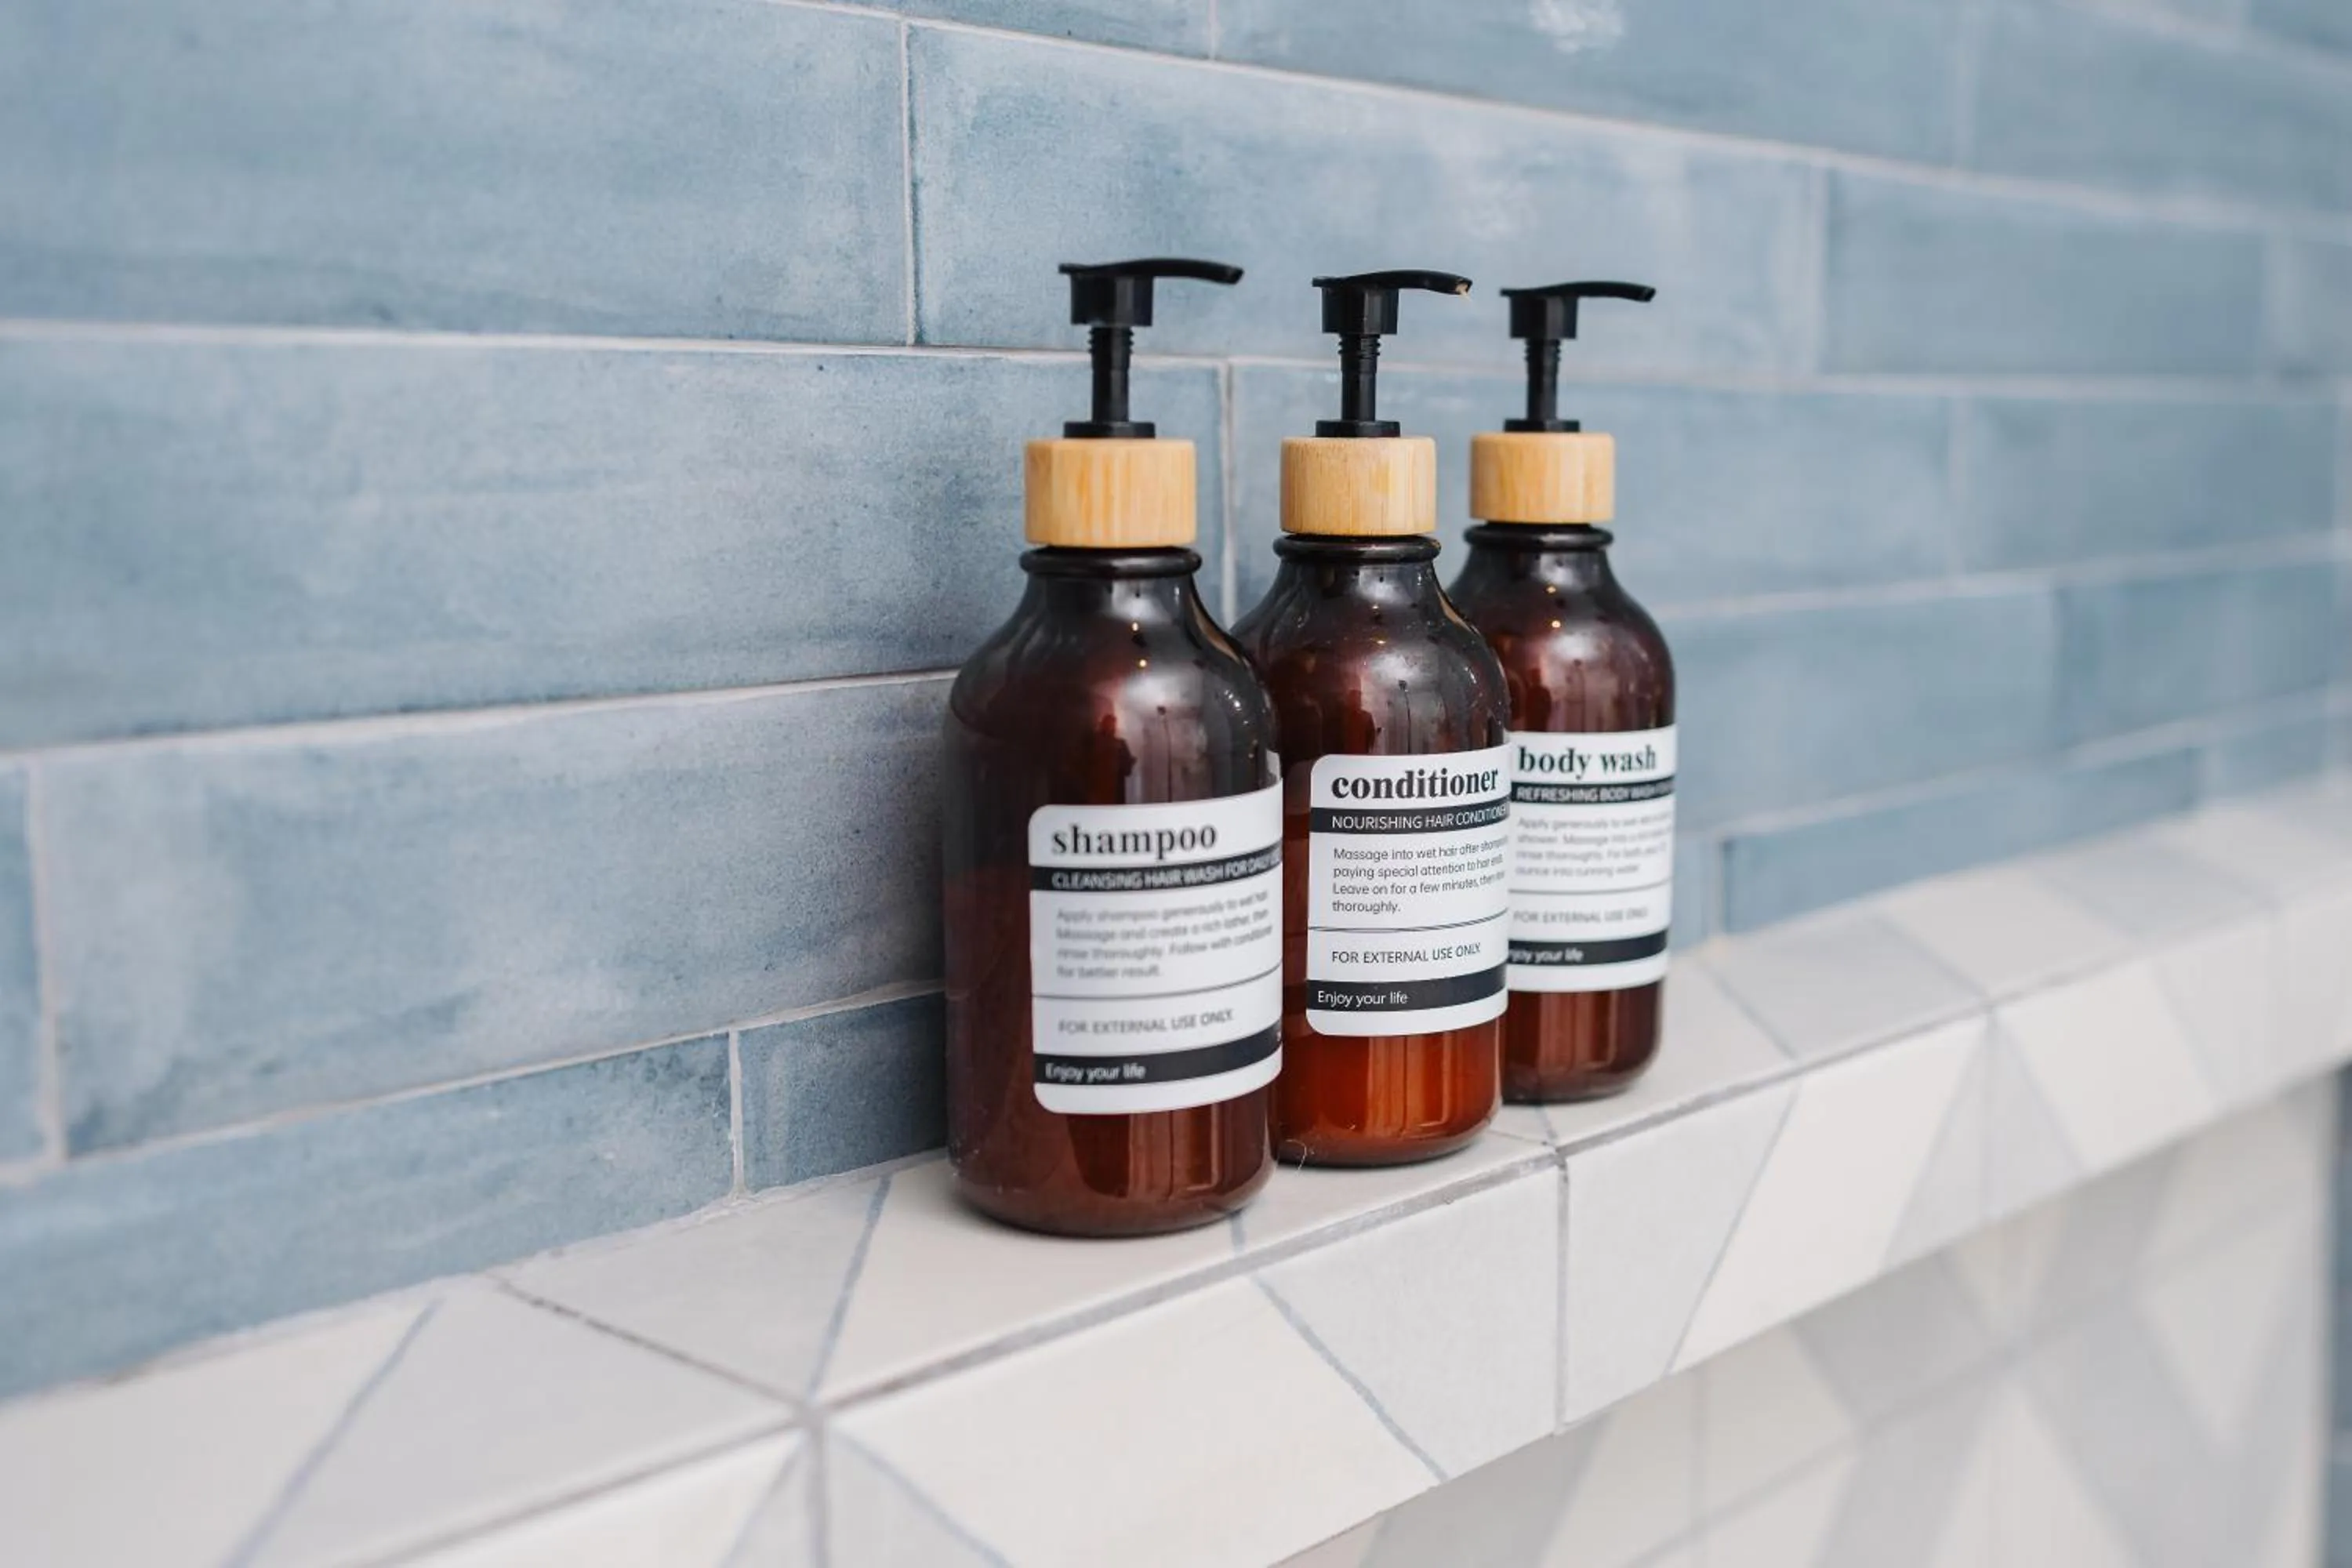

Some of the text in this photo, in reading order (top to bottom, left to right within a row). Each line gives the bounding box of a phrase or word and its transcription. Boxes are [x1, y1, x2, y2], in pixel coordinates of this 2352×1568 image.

[1518, 744, 1656, 779] body wash
[1331, 768, 1498, 799] conditioner
[1516, 786, 1599, 802] REFRESHING
[1599, 786, 1628, 801] BODY
[1331, 815, 1423, 830] NOURISHING
[1425, 812, 1454, 828] HAIR
[1051, 823, 1218, 860] shampoo
[1333, 848, 1388, 863] Massage
[1392, 848, 1414, 860] into
[1416, 847, 1437, 858] wet
[1439, 845, 1457, 857] hair
[1459, 843, 1479, 855] after
[1051, 871, 1143, 890] CLEANSING
[1144, 869, 1181, 887] HAIR
[1183, 865, 1224, 884] WASH
[1225, 859, 1247, 877] FOR
[1333, 866, 1374, 880] paying
[1377, 865, 1418, 880] special
[1420, 862, 1465, 877] attention
[1467, 861, 1475, 872] to
[1333, 882, 1370, 895] Leave
[1372, 884, 1388, 895] on
[1390, 882, 1406, 895] for
[1409, 884, 1417, 895] a
[1420, 881, 1440, 893] few
[1442, 878, 1479, 892] minutes,
[1057, 908, 1093, 924] Apply
[1332, 899, 1401, 915] thoroughly.
[1513, 910, 1538, 924] FOR
[1543, 910, 1602, 924] EXTERNAL
[1332, 950, 1359, 964] FOR
[1363, 949, 1429, 964] EXTERNAL
[1432, 946, 1454, 961] USE
[1508, 947, 1584, 964] njoy your life
[1317, 989, 1409, 1008] Enjoy your life
[1058, 1020, 1087, 1035] FOR
[1092, 1017, 1167, 1034] EXTERNAL
[1171, 1014, 1197, 1029] USE
[1045, 1062, 1146, 1083] Enjoy your life
